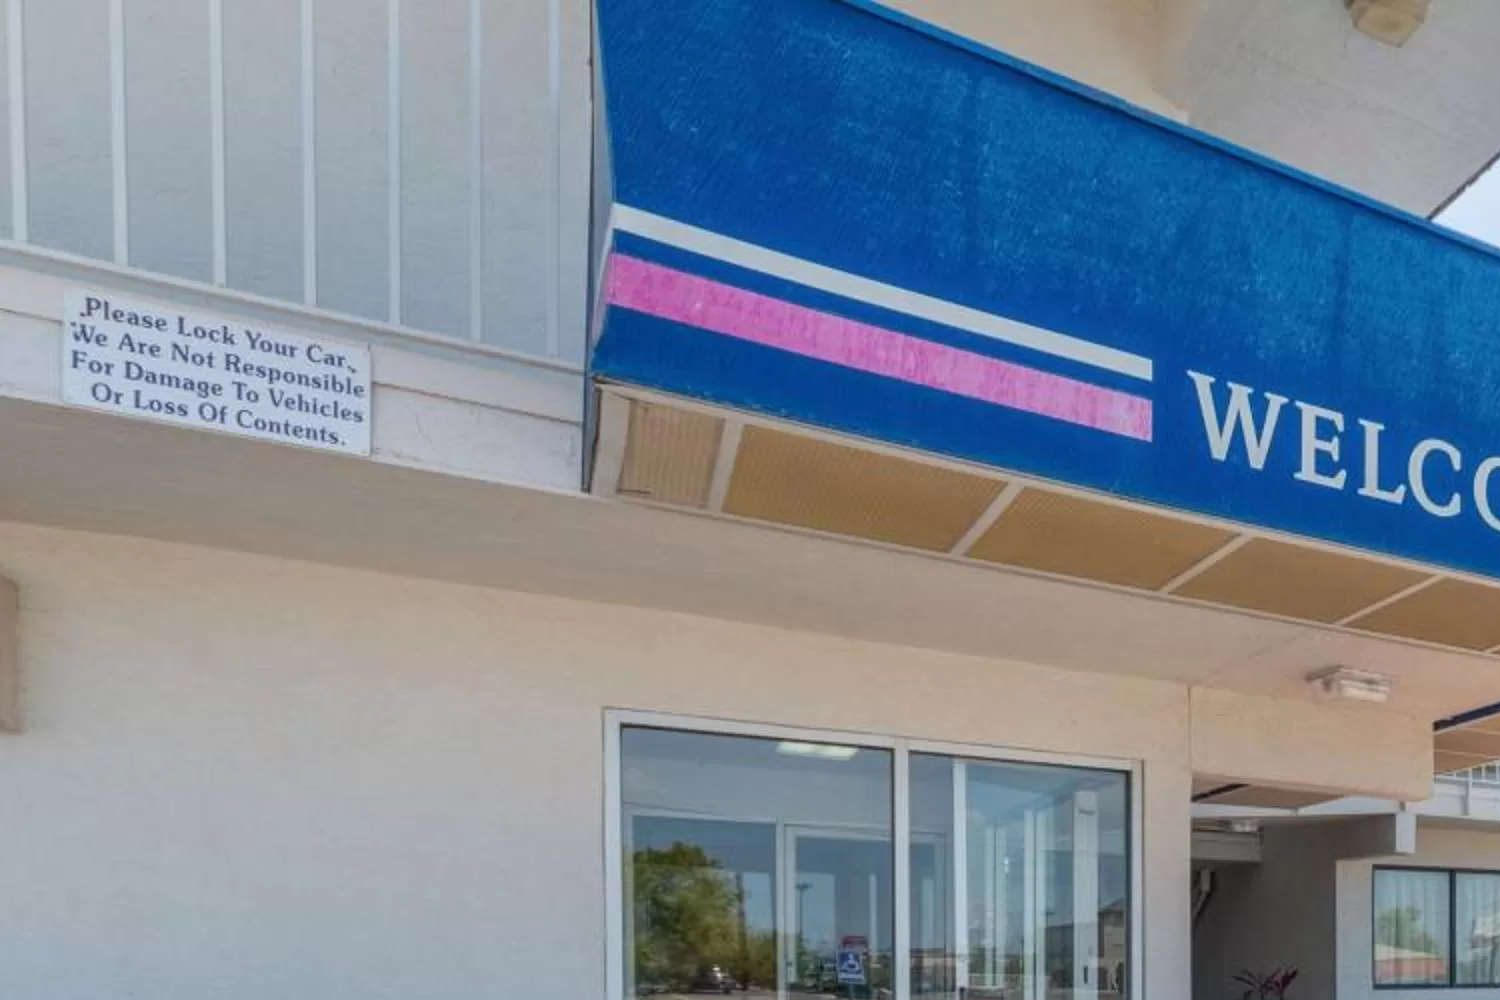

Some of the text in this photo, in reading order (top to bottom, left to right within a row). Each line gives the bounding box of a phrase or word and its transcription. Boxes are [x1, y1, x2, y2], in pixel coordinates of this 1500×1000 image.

[72, 321, 366, 398] We Are Not Responsible
[84, 297, 168, 332] Please
[177, 315, 236, 345] Lock
[245, 329, 299, 358] Your
[71, 349, 365, 423] For Damage To Vehicles
[91, 382, 347, 446] Or Loss Of Contents.
